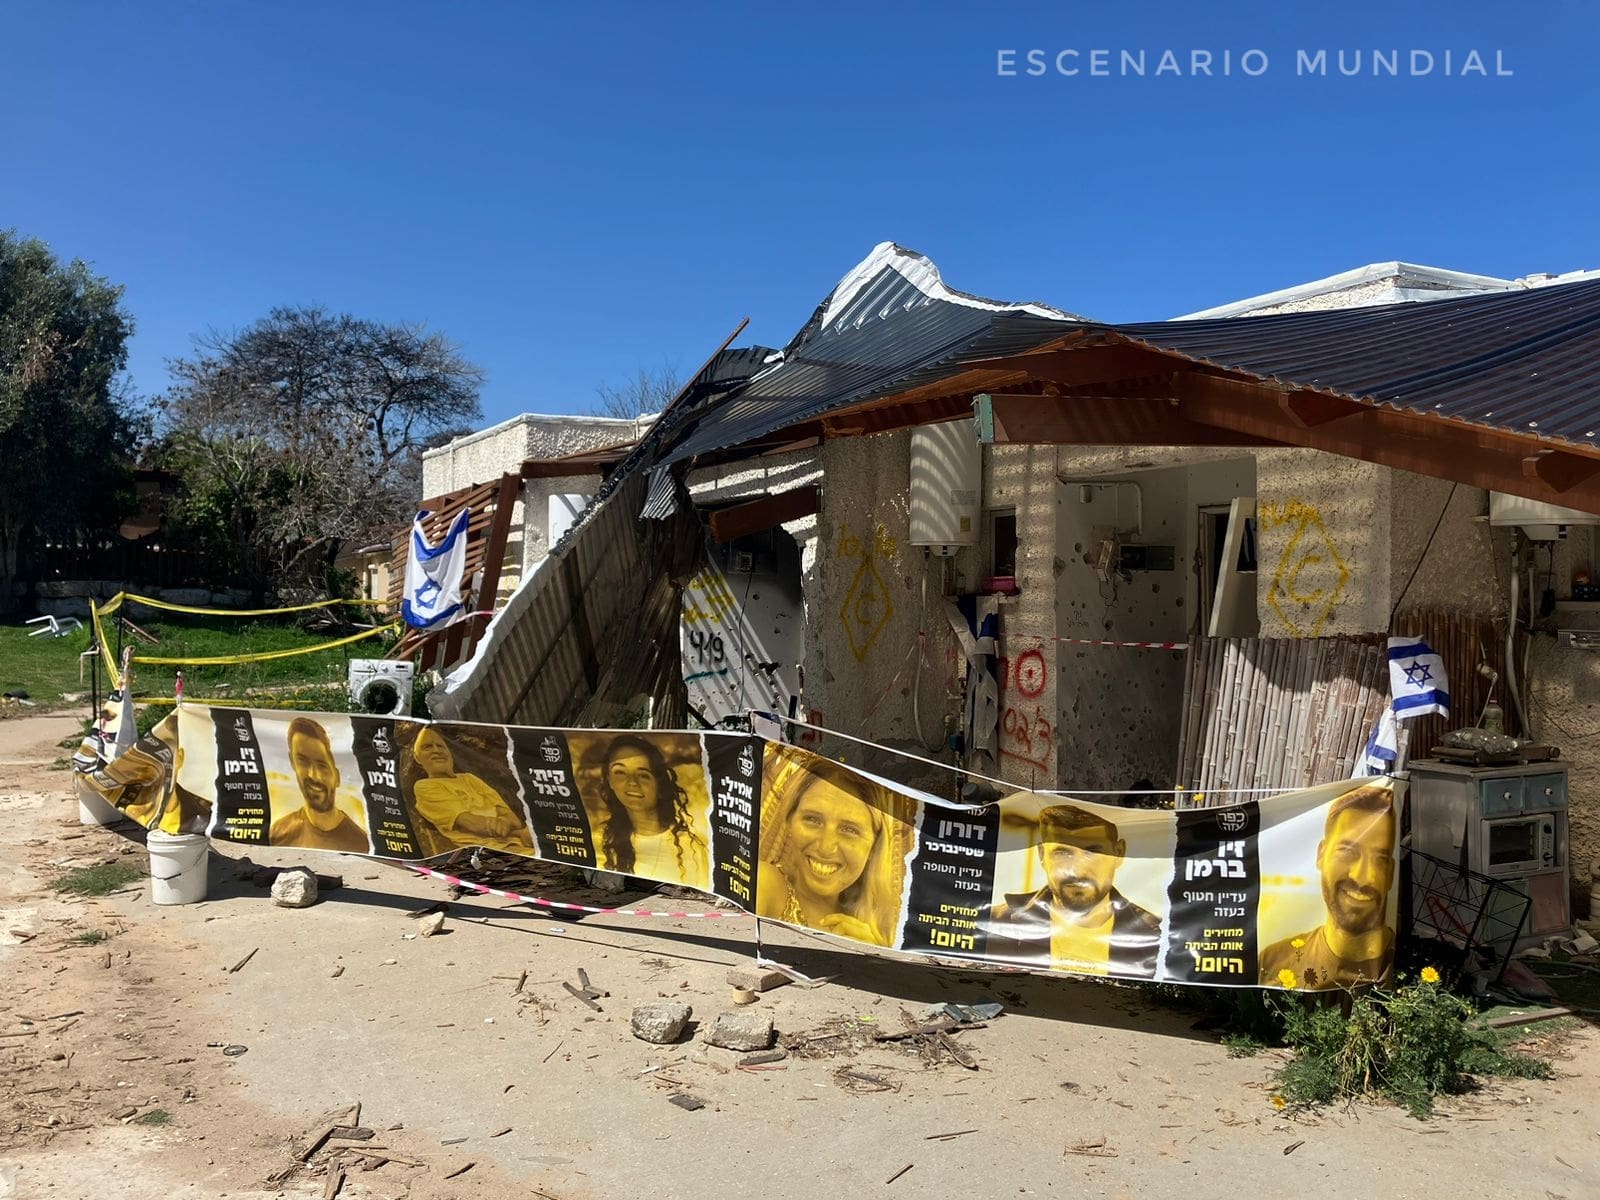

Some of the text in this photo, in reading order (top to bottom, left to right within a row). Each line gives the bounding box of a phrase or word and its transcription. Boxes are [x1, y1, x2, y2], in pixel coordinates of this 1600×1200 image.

[240, 747, 255, 760] זיו
[541, 747, 560, 756] כפר
[544, 754, 561, 762] עזה
[224, 760, 259, 776] ברמן
[376, 756, 396, 774] גלי
[739, 757, 753, 768] כפר
[367, 771, 397, 788] ברמן
[720, 775, 753, 800] אמילי
[532, 780, 571, 797] סיגל
[717, 792, 752, 817] תהילה
[718, 809, 752, 833] דמארי
[1218, 812, 1245, 823] כפר
[229, 828, 261, 840] היום!
[938, 819, 987, 841] דורון
[1222, 822, 1245, 832] עזה
[385, 839, 413, 853] היום!
[556, 843, 587, 858] היום!
[925, 841, 984, 857] שטיינברכר
[1218, 840, 1246, 858] זיו
[923, 861, 982, 878] עדיין חטופה
[1185, 859, 1246, 881] ברמן
[729, 876, 750, 901] היום!
[954, 880, 981, 892] בעזה
[1182, 891, 1247, 904] עדיין חטוף
[940, 904, 979, 917] מחזירים
[1214, 906, 1245, 917] בעזה
[918, 913, 977, 930] אותה הביתה
[929, 928, 975, 950] היום!
[1203, 928, 1244, 938] מחזירים
[1185, 941, 1243, 951] אותו הביתה
[1195, 956, 1243, 974] היום!
